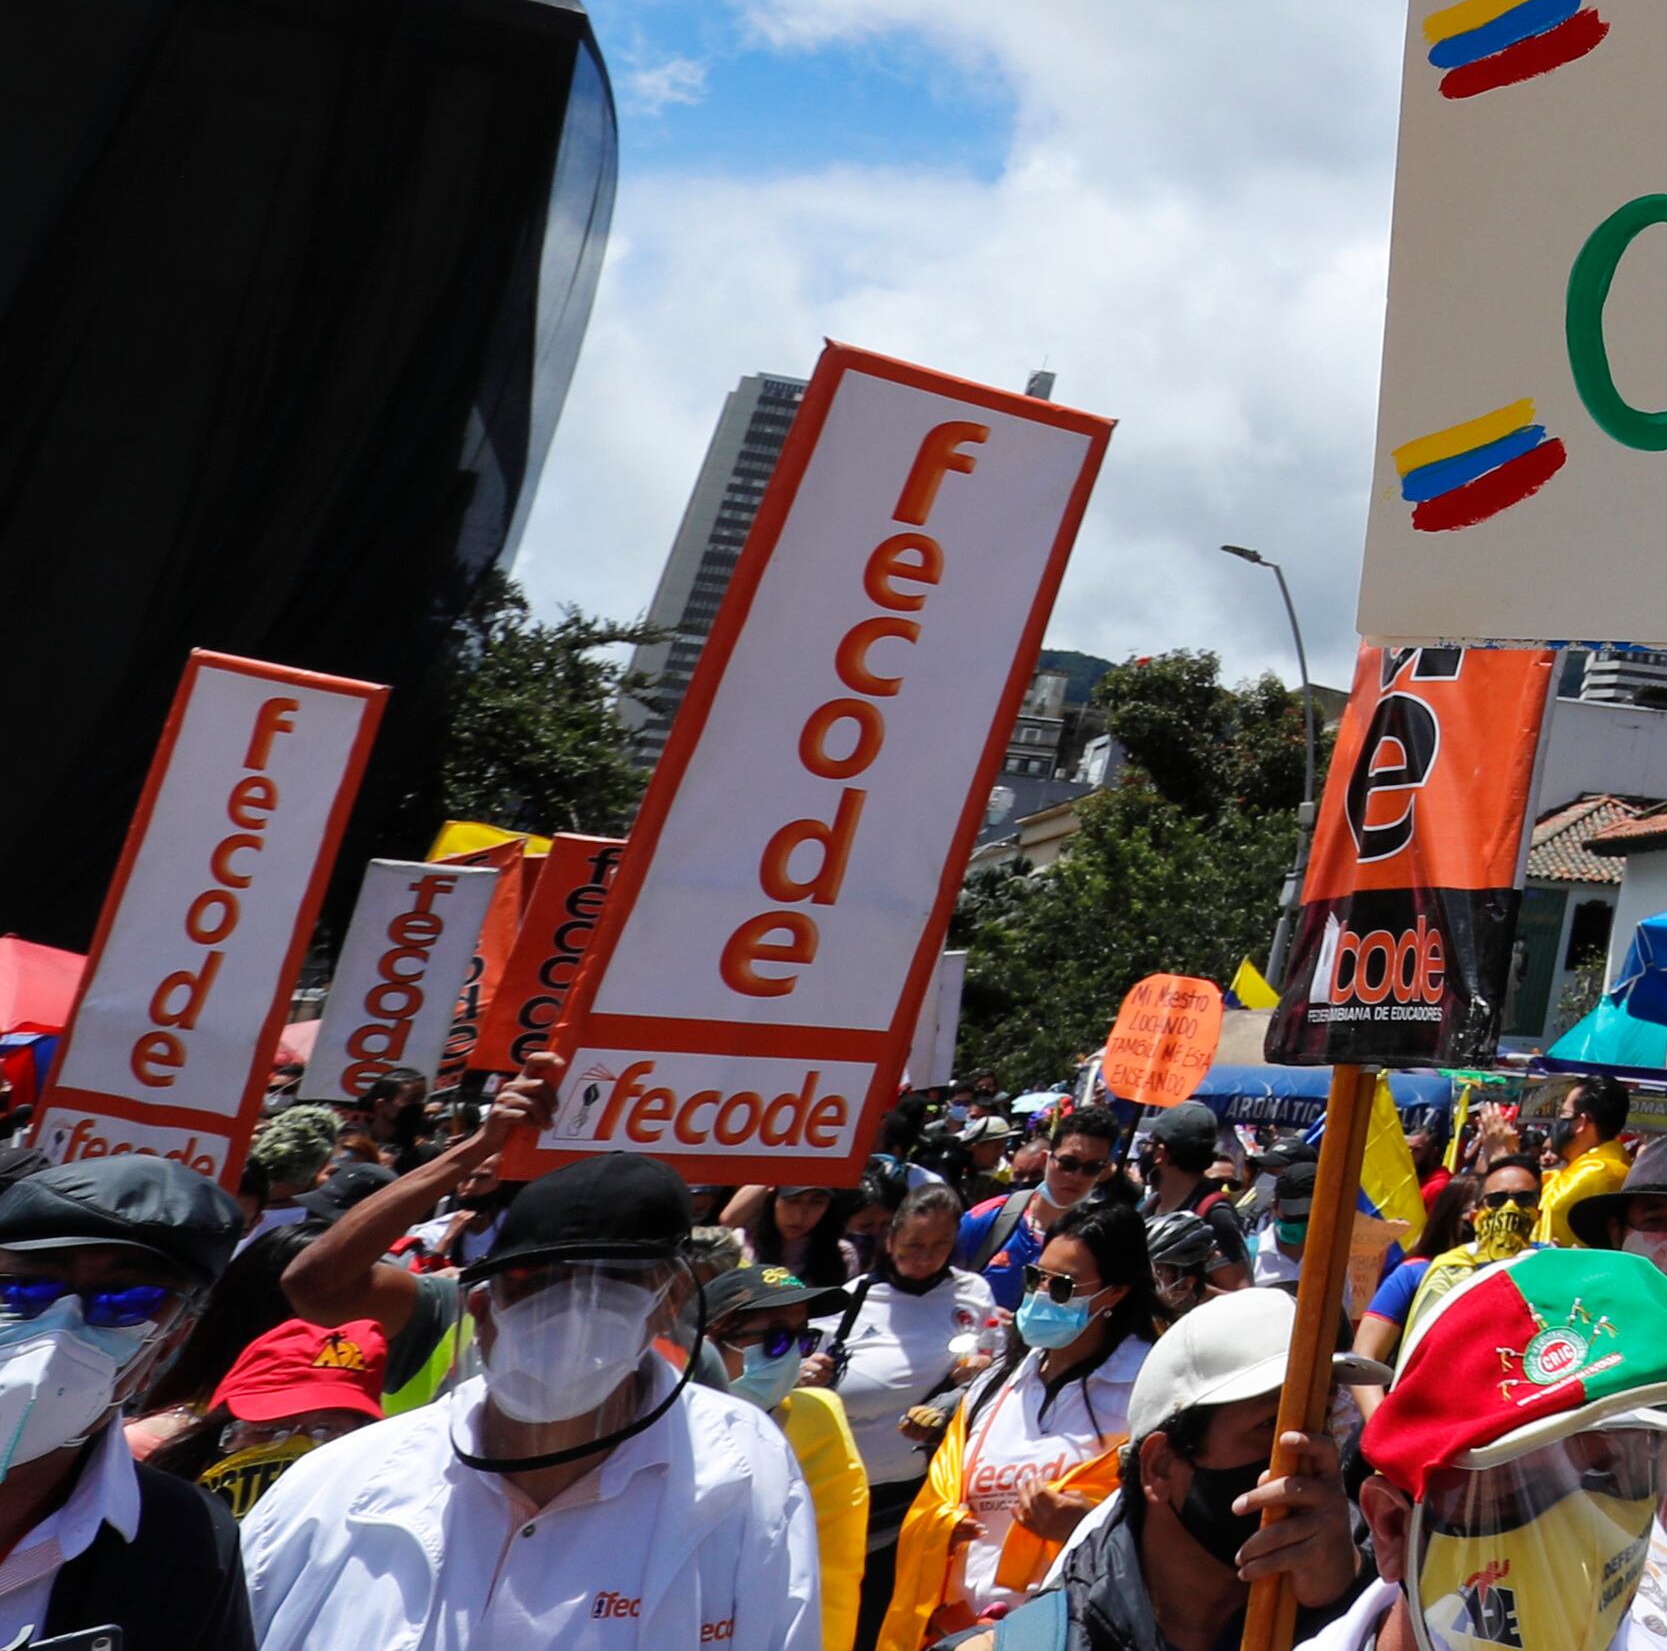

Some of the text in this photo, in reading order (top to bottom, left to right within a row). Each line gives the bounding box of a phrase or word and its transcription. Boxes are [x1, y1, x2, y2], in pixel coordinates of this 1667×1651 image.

[719, 420, 991, 998] fecode
[130, 697, 299, 1088] fecode
[1374, 1006, 1390, 1021] DE
[1391, 1006, 1443, 1021] EDUCADORES
[600, 1059, 849, 1149] fecode
[1541, 1343, 1575, 1371] CRIC
